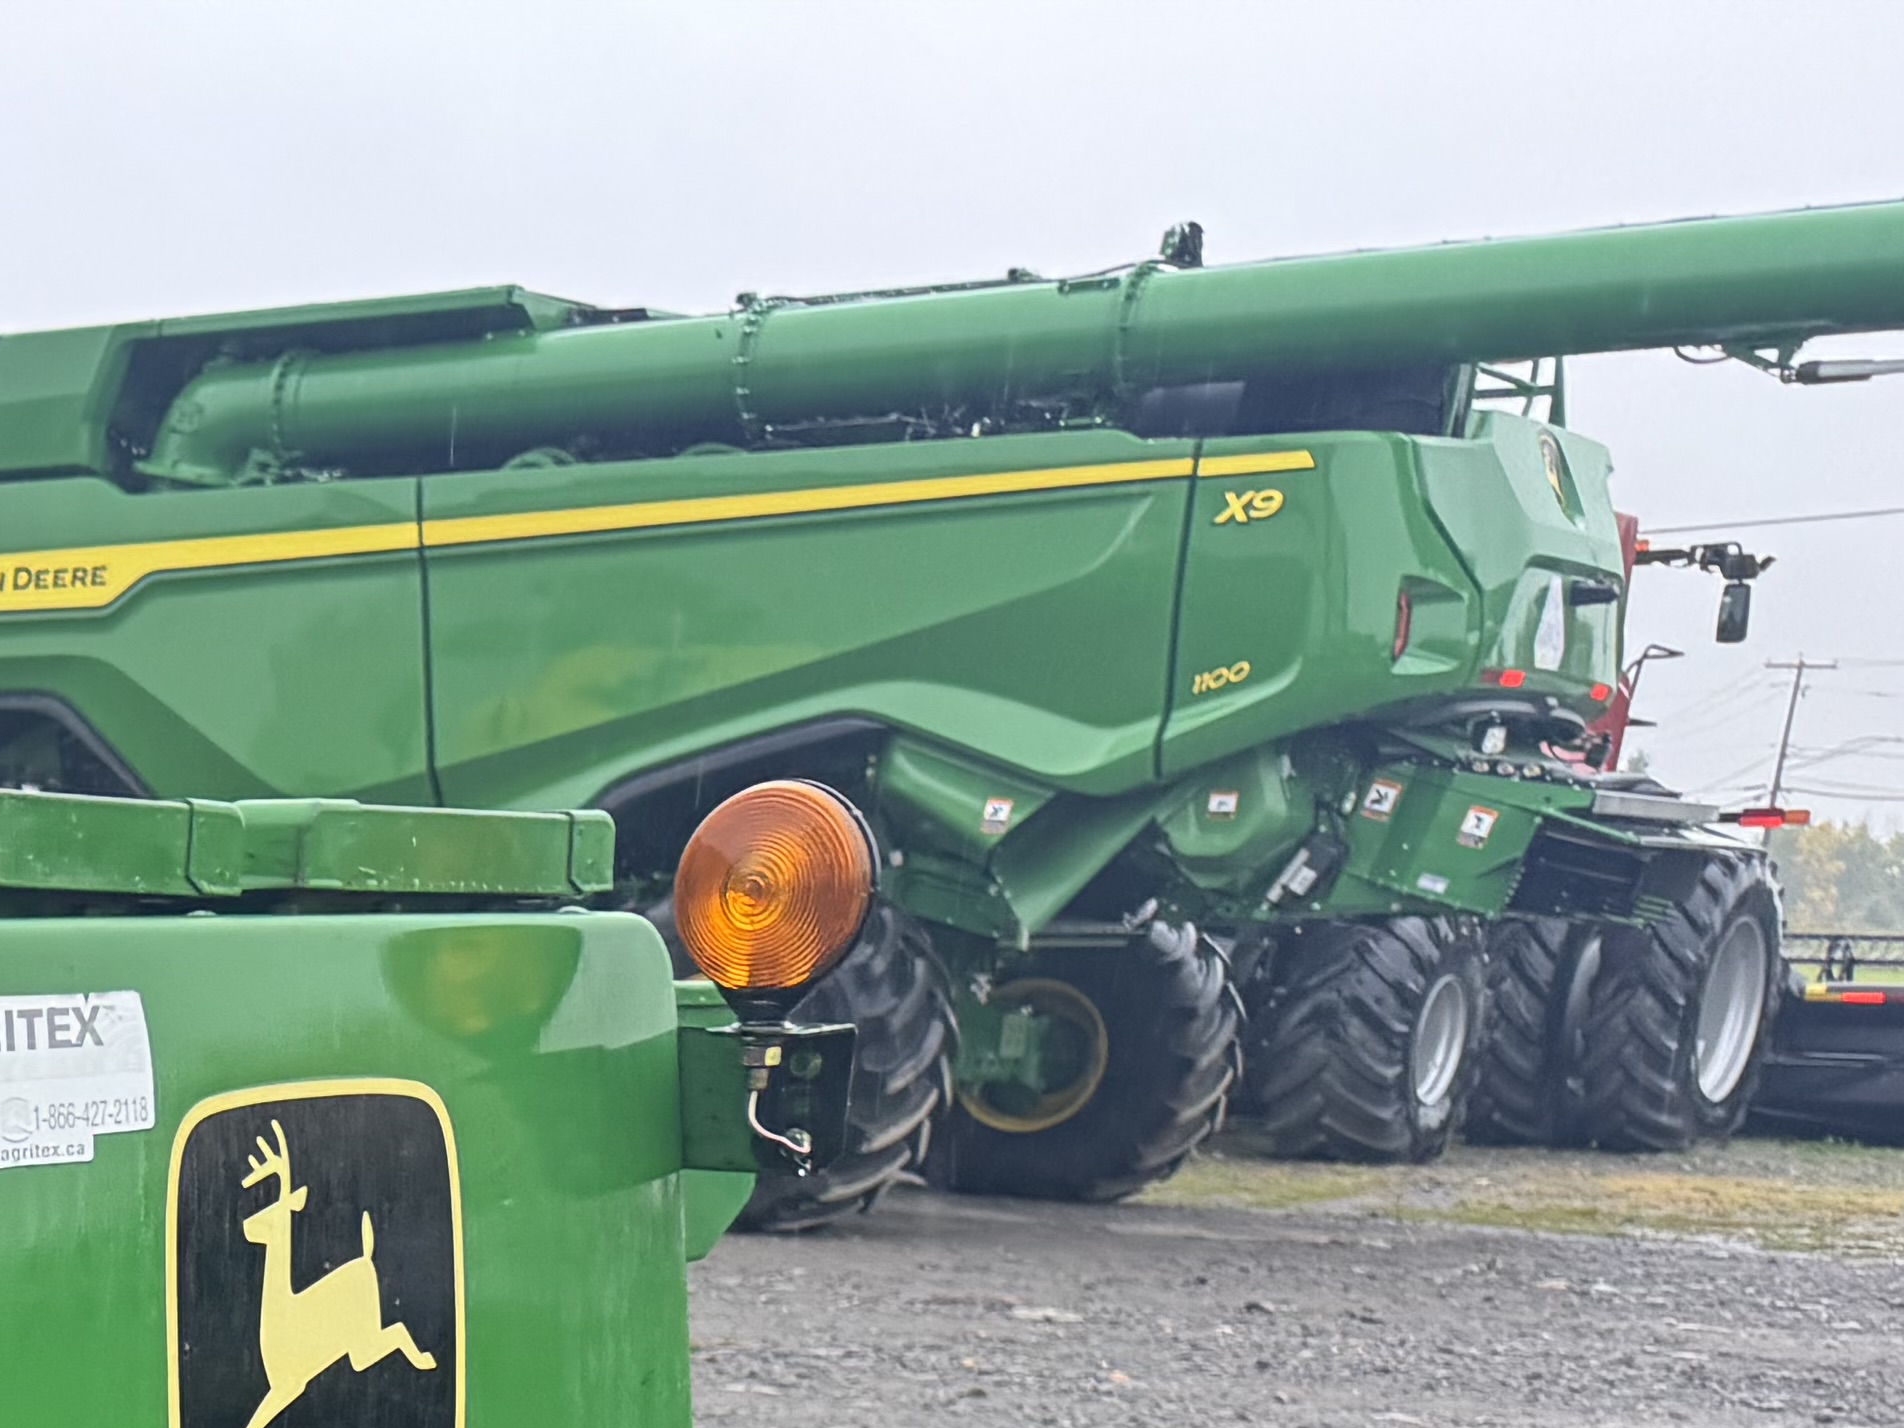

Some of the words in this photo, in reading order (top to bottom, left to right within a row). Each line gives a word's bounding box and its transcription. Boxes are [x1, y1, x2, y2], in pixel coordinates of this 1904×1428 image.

[1211, 488, 1285, 525] X9
[13, 565, 108, 591] DEERE
[1192, 660, 1251, 694] 1100
[34, 1096, 149, 1131] 1-866-427-2118
